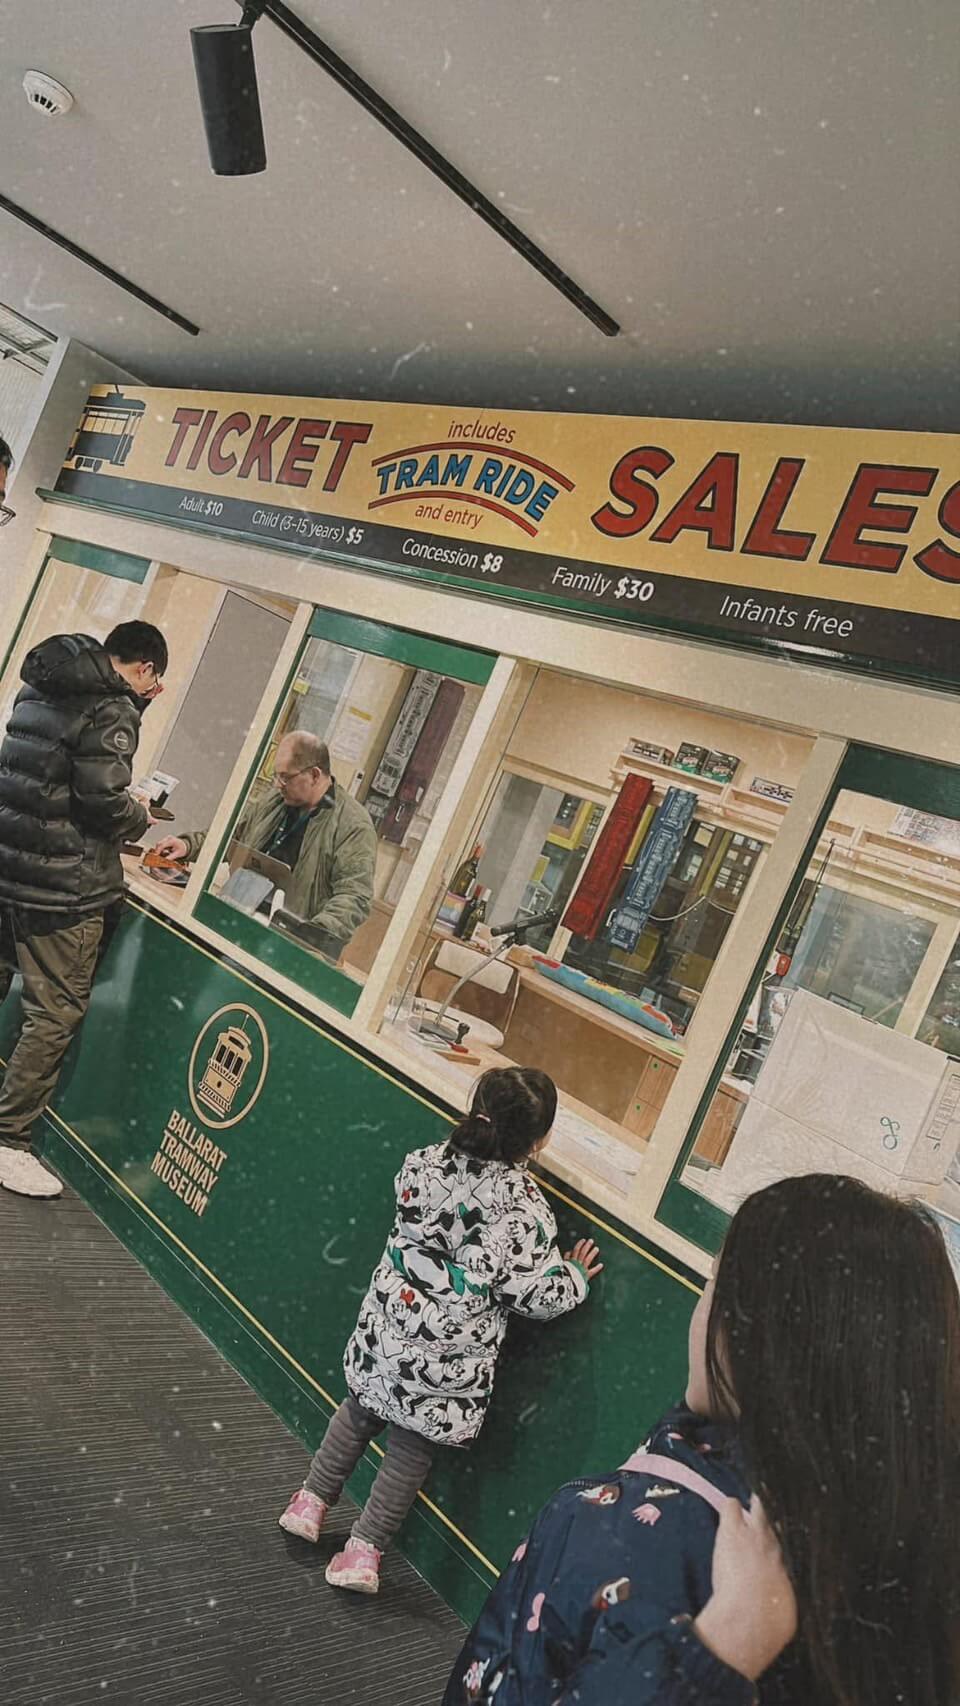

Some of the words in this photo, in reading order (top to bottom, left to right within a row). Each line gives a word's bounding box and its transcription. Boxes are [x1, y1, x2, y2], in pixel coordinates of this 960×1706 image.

[165, 407, 373, 492] TICKET
[448, 420, 516, 444] includes
[179, 496, 205, 513] Adult
[204, 501, 224, 517] $10
[377, 454, 473, 495] TRAM
[473, 458, 559, 522] RIDE
[252, 510, 280, 528] Child
[308, 523, 345, 543] years)
[345, 527, 365, 545] $5
[415, 504, 444, 521] and
[444, 509, 484, 529] entry
[401, 538, 479, 569] Concession
[480, 552, 504, 573] $8
[551, 566, 612, 597] Family
[614, 576, 655, 601] $30
[719, 595, 799, 628] Infants
[803, 609, 853, 638] free
[167, 1109, 228, 1172] BALLARAT
[160, 1129, 218, 1193] TRAMWAY
[150, 1151, 208, 1217] MUSEUM
